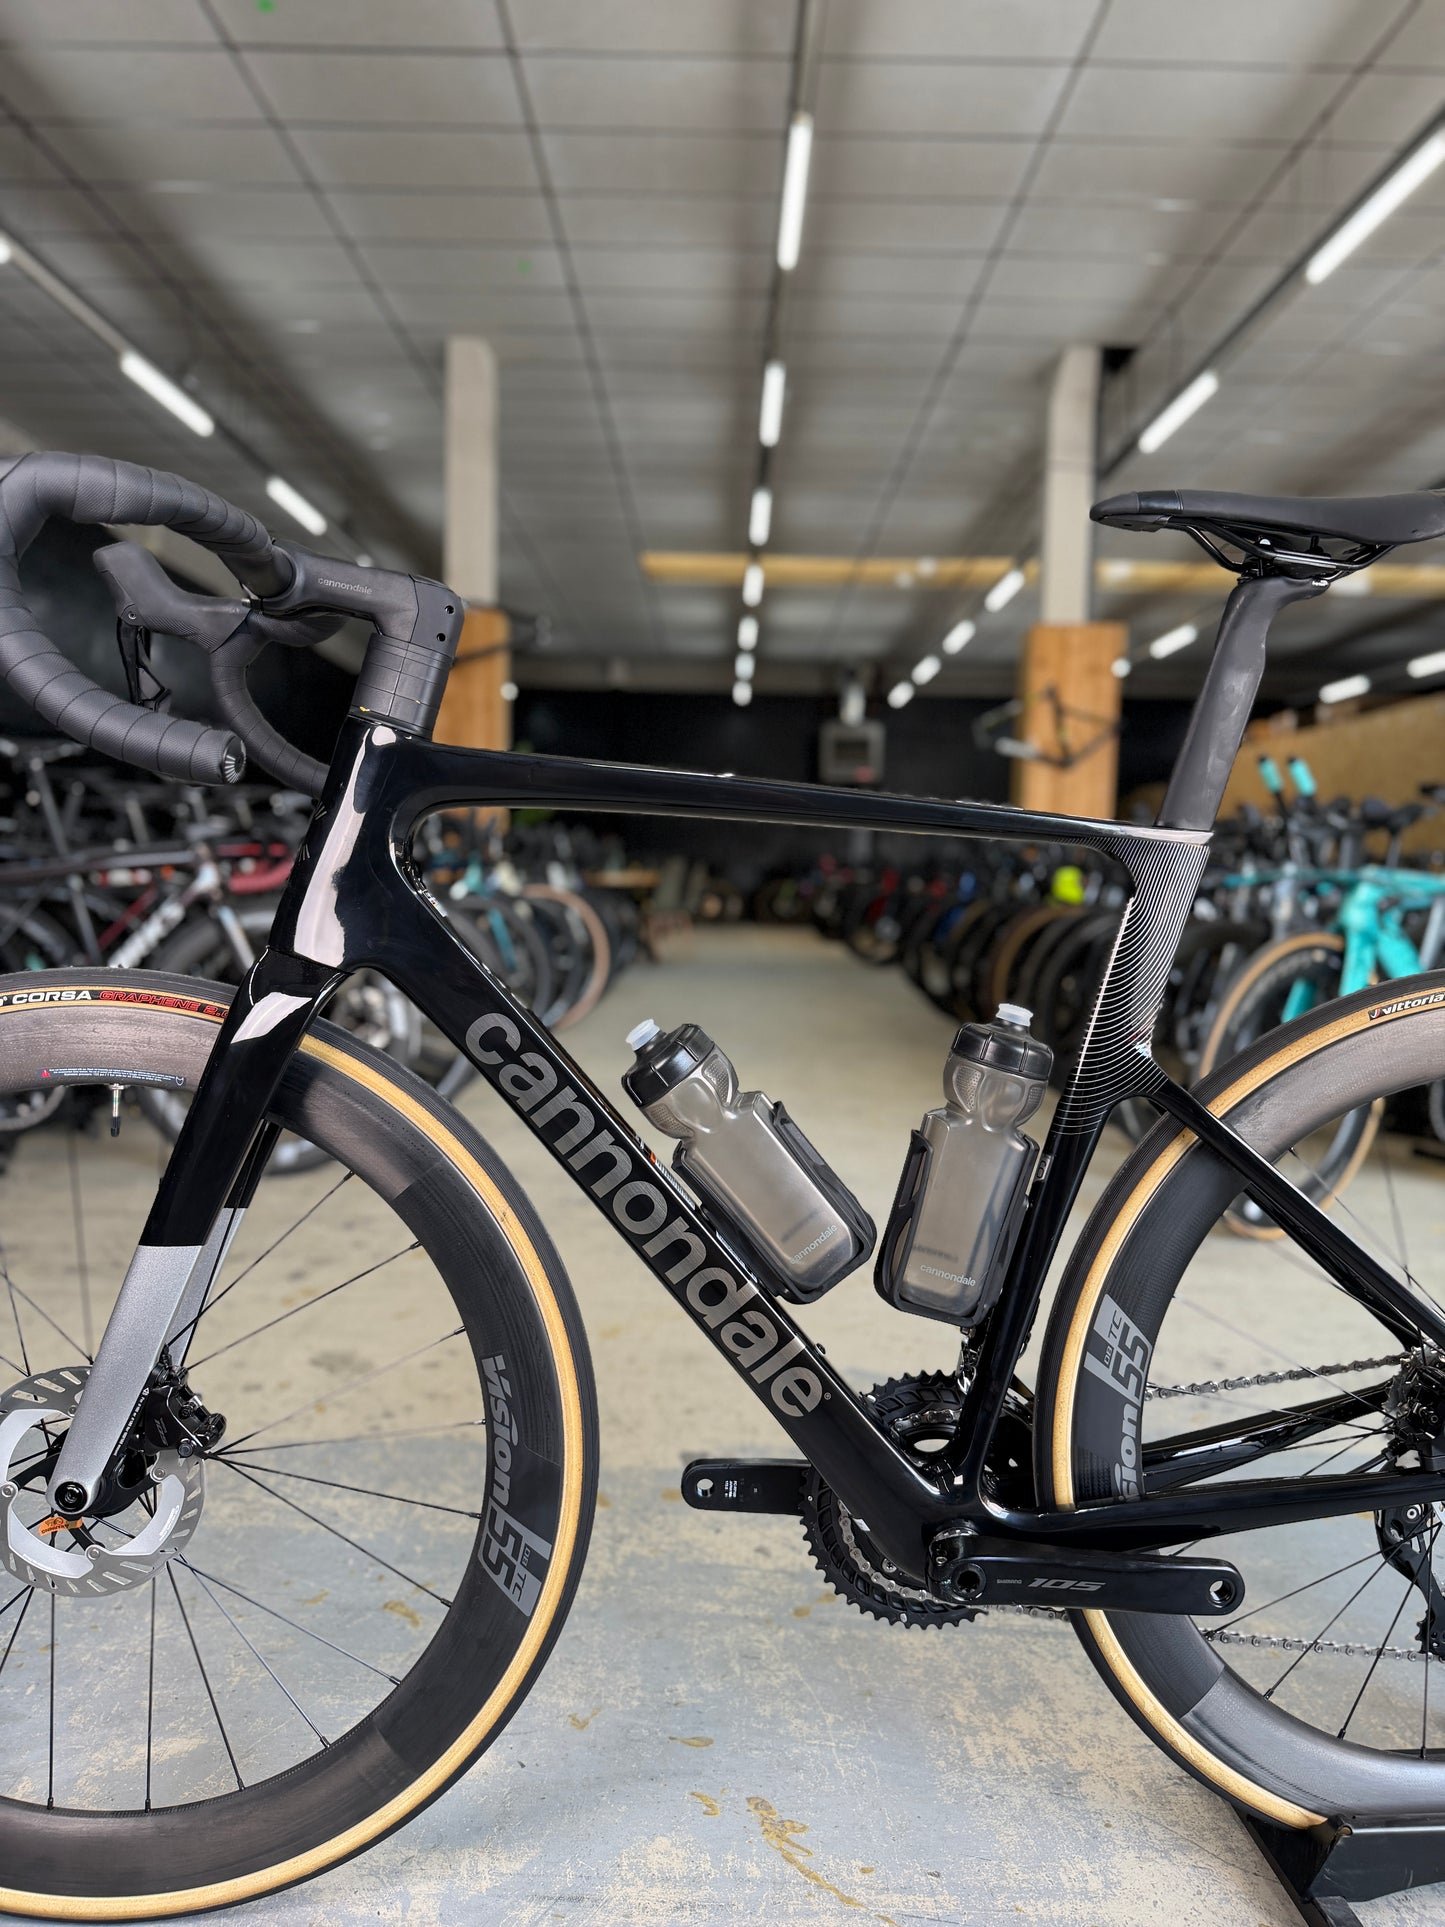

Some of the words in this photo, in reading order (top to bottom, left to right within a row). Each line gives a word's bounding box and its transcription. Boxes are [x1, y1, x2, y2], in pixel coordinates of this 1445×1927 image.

[12, 990, 92, 1005] CORSA
[99, 990, 201, 1013] GRAPHENE
[1382, 992, 1445, 1015] vittoria
[465, 1012, 824, 1417] cannondale
[790, 1224, 838, 1265] cannondale
[919, 1263, 977, 1287] cannondale
[1110, 1321, 1149, 1400] 55
[482, 1507, 524, 1591] 55
[1027, 1577, 1107, 1592] 105
